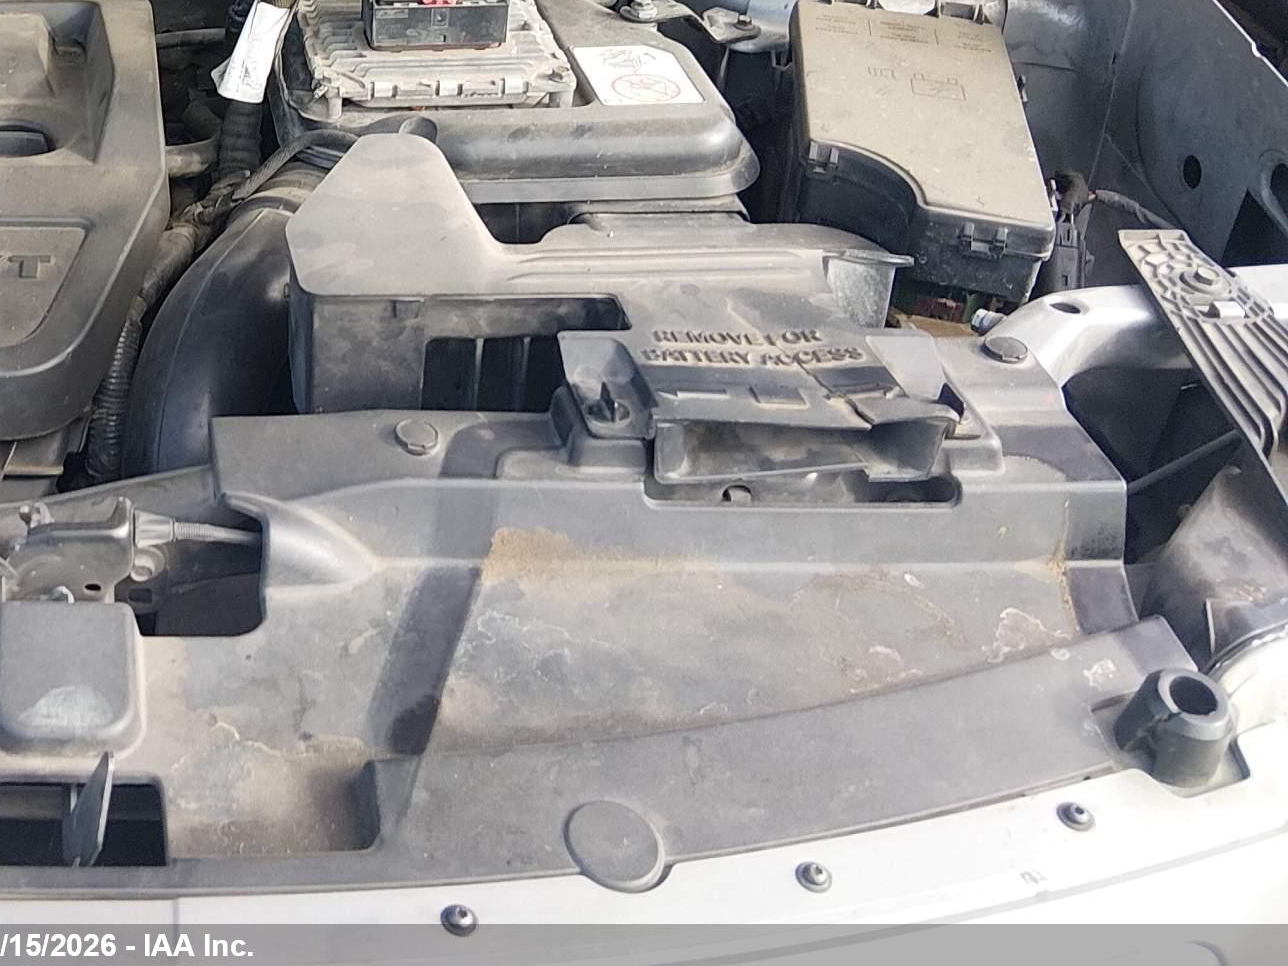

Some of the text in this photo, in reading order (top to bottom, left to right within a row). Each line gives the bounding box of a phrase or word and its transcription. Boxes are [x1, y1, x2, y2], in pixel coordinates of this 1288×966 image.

[652, 329, 762, 346] REMOVE
[640, 346, 865, 366] BATTERY ACCESS
